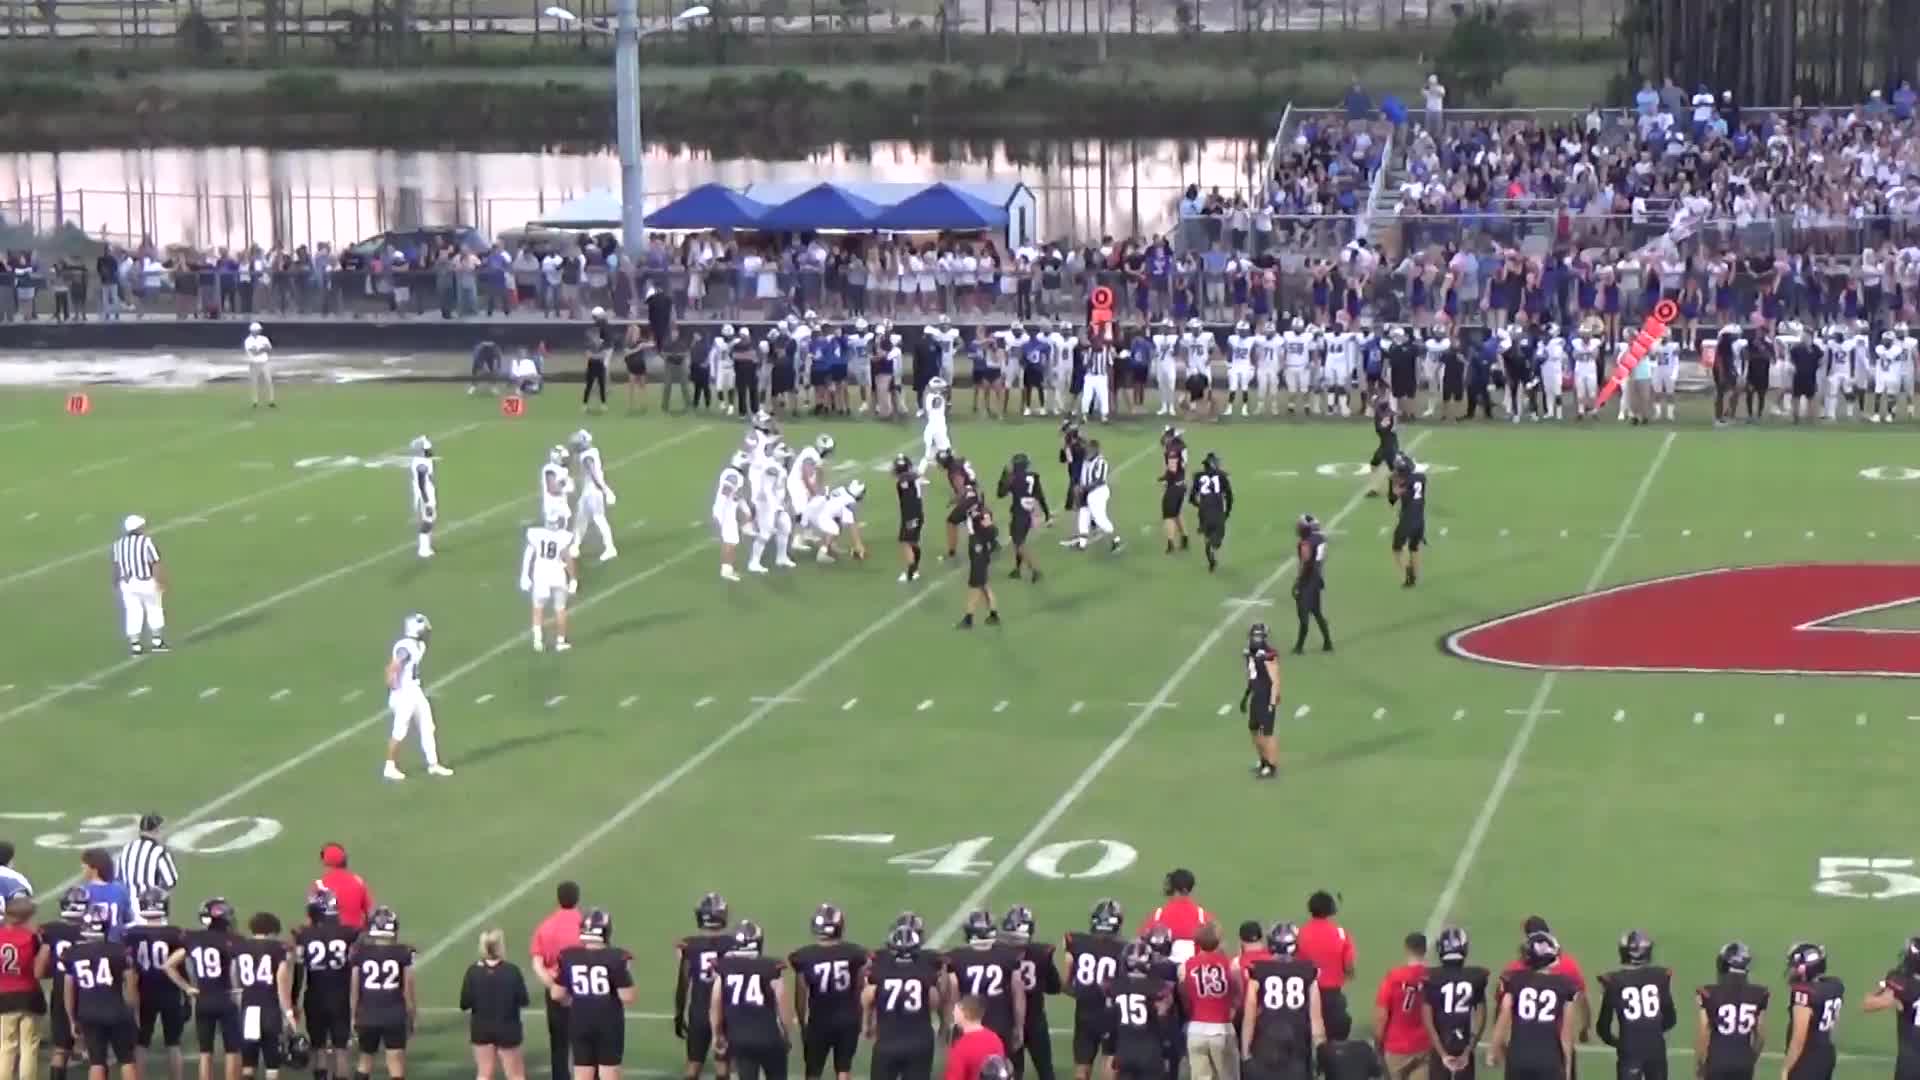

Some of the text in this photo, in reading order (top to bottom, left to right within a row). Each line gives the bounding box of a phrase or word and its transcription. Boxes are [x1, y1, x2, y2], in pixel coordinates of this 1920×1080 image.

[1026, 475, 1034, 495] 7
[1200, 475, 1220, 494] 21
[1413, 482, 1422, 499] 2
[540, 540, 556, 559] 18
[888, 837, 1137, 878] 40
[137, 941, 169, 970] 40
[191, 947, 221, 977] 19
[240, 954, 273, 985] 84
[308, 940, 347, 971] 23
[1077, 953, 1116, 985] 80
[75, 957, 113, 988] 54
[363, 960, 399, 989] 22
[571, 965, 610, 995] 56
[814, 961, 850, 993] 75
[967, 965, 1003, 996] 72
[1190, 967, 1229, 998] 13
[727, 974, 764, 1006] 74
[884, 979, 922, 1011] 73
[1264, 976, 1305, 1009] 88
[1441, 982, 1472, 1013] 12
[1518, 987, 1557, 1021] 62
[1621, 984, 1660, 1020] 36
[1115, 994, 1147, 1025] 15
[1718, 1004, 1757, 1034] 35
